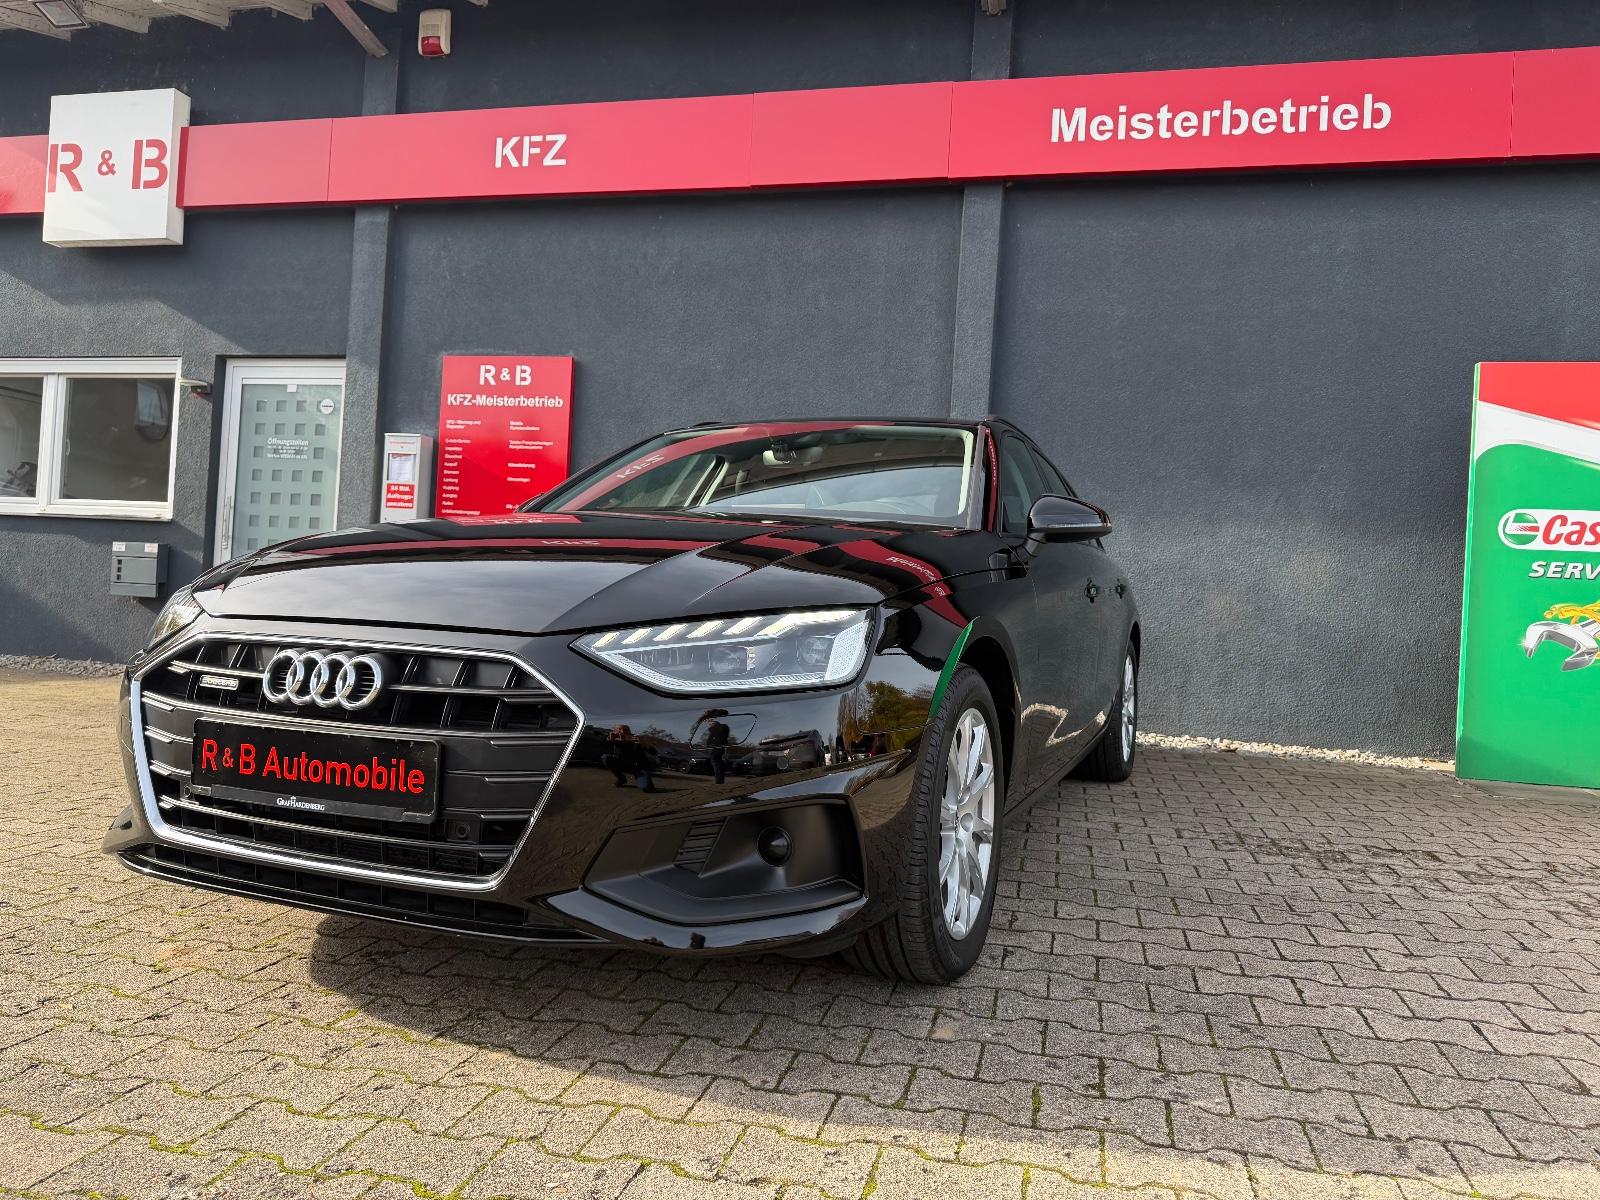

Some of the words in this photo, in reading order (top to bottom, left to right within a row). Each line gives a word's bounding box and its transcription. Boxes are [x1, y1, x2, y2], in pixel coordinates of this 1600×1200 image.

[1051, 93, 1392, 142] Meisterbetrieb
[48, 143, 83, 193] R
[97, 150, 117, 176] &
[131, 139, 168, 190] B
[495, 134, 567, 168] KFZ
[479, 365, 496, 386] R
[500, 367, 511, 381] &
[515, 365, 532, 386] B
[447, 393, 564, 408] KFZ-Meisterbetrieb
[202, 739, 218, 771] R
[222, 747, 234, 768] &
[239, 743, 256, 775] B
[262, 746, 425, 794] Automobile
